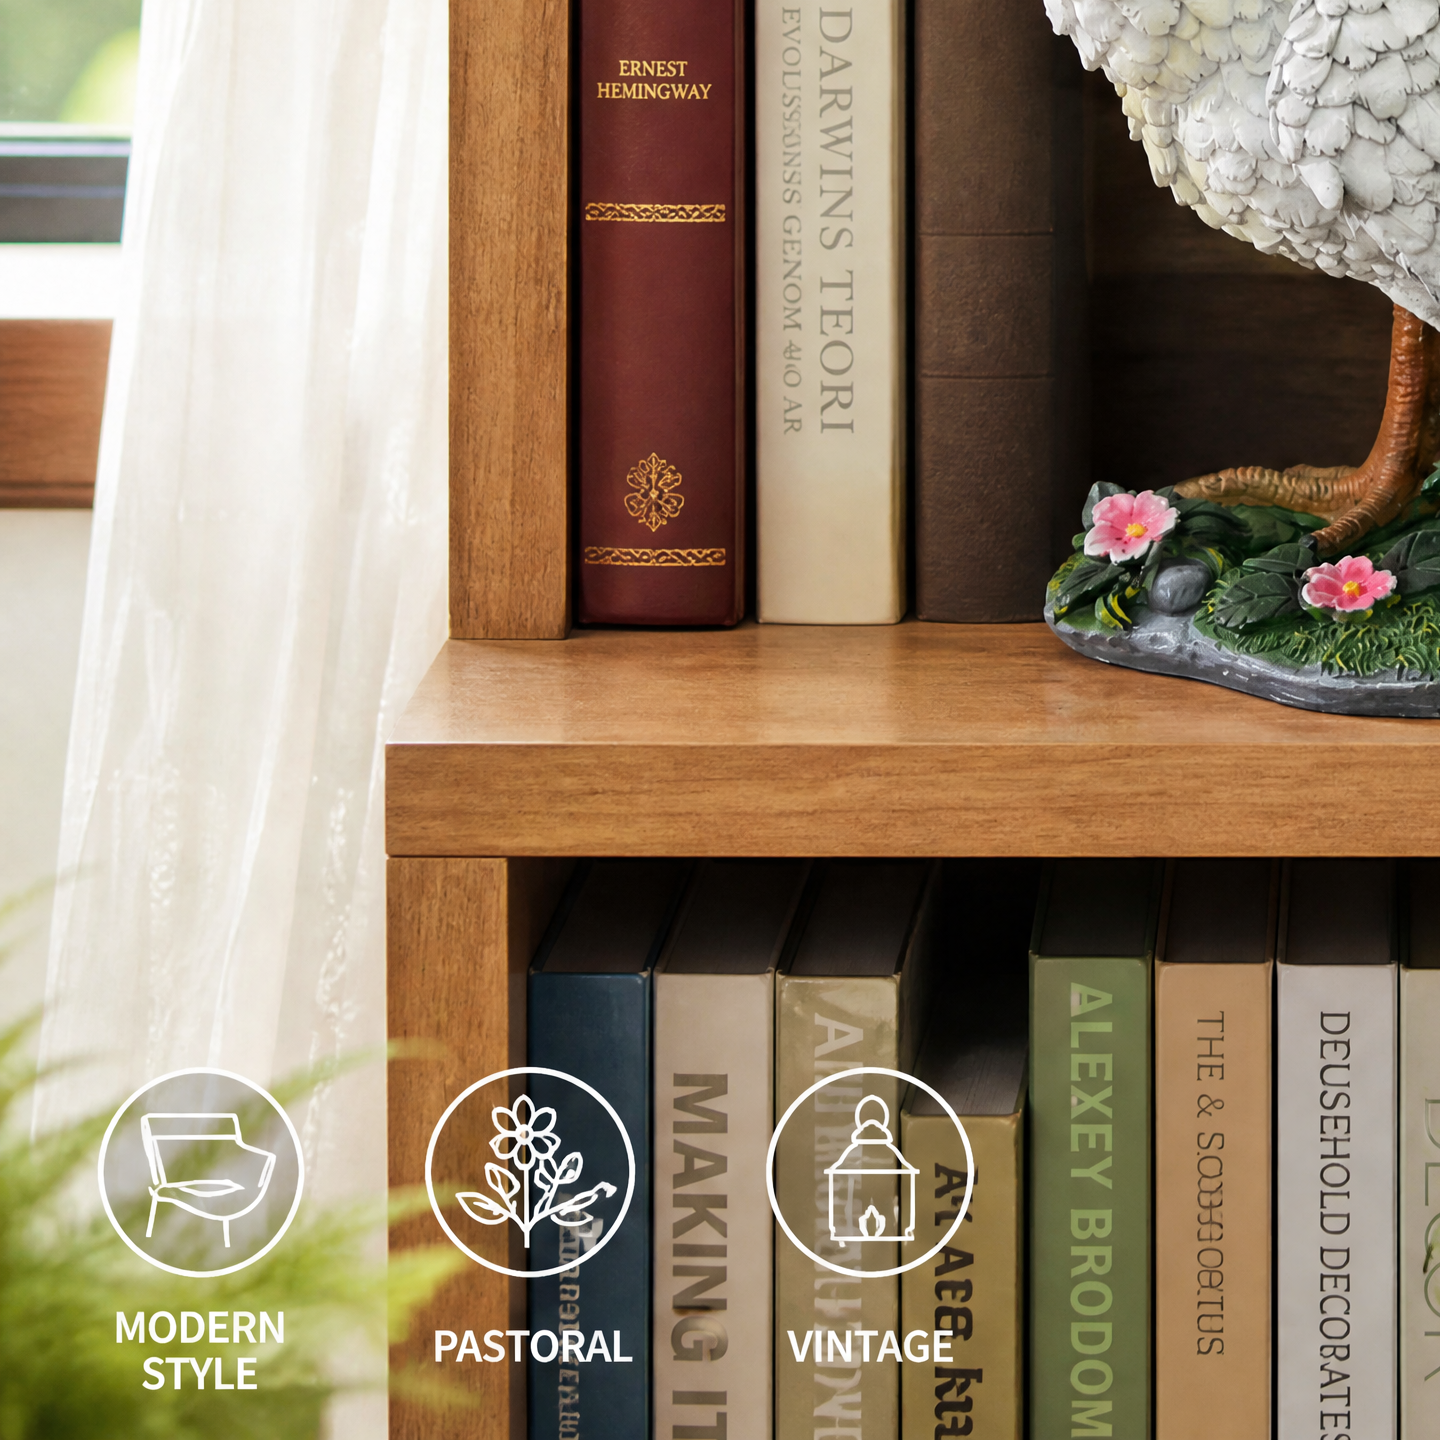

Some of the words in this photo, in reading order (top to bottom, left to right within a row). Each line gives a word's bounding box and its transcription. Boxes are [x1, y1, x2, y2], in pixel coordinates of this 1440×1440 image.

[598, 83, 711, 99] HEMINGWAY
[619, 60, 687, 76] ERNEST
[820, 8, 853, 250] DARWINS
[783, 215, 801, 330] GENOM
[820, 270, 854, 433] TEORI
[1070, 983, 1112, 1189] ALEXEY
[1197, 1011, 1224, 1080] THE
[1197, 1094, 1224, 1118] &
[1320, 1012, 1350, 1234] DEUSEHOLD
[671, 1073, 727, 1361] MAKING
[1070, 1209, 1113, 1437] BRODOM
